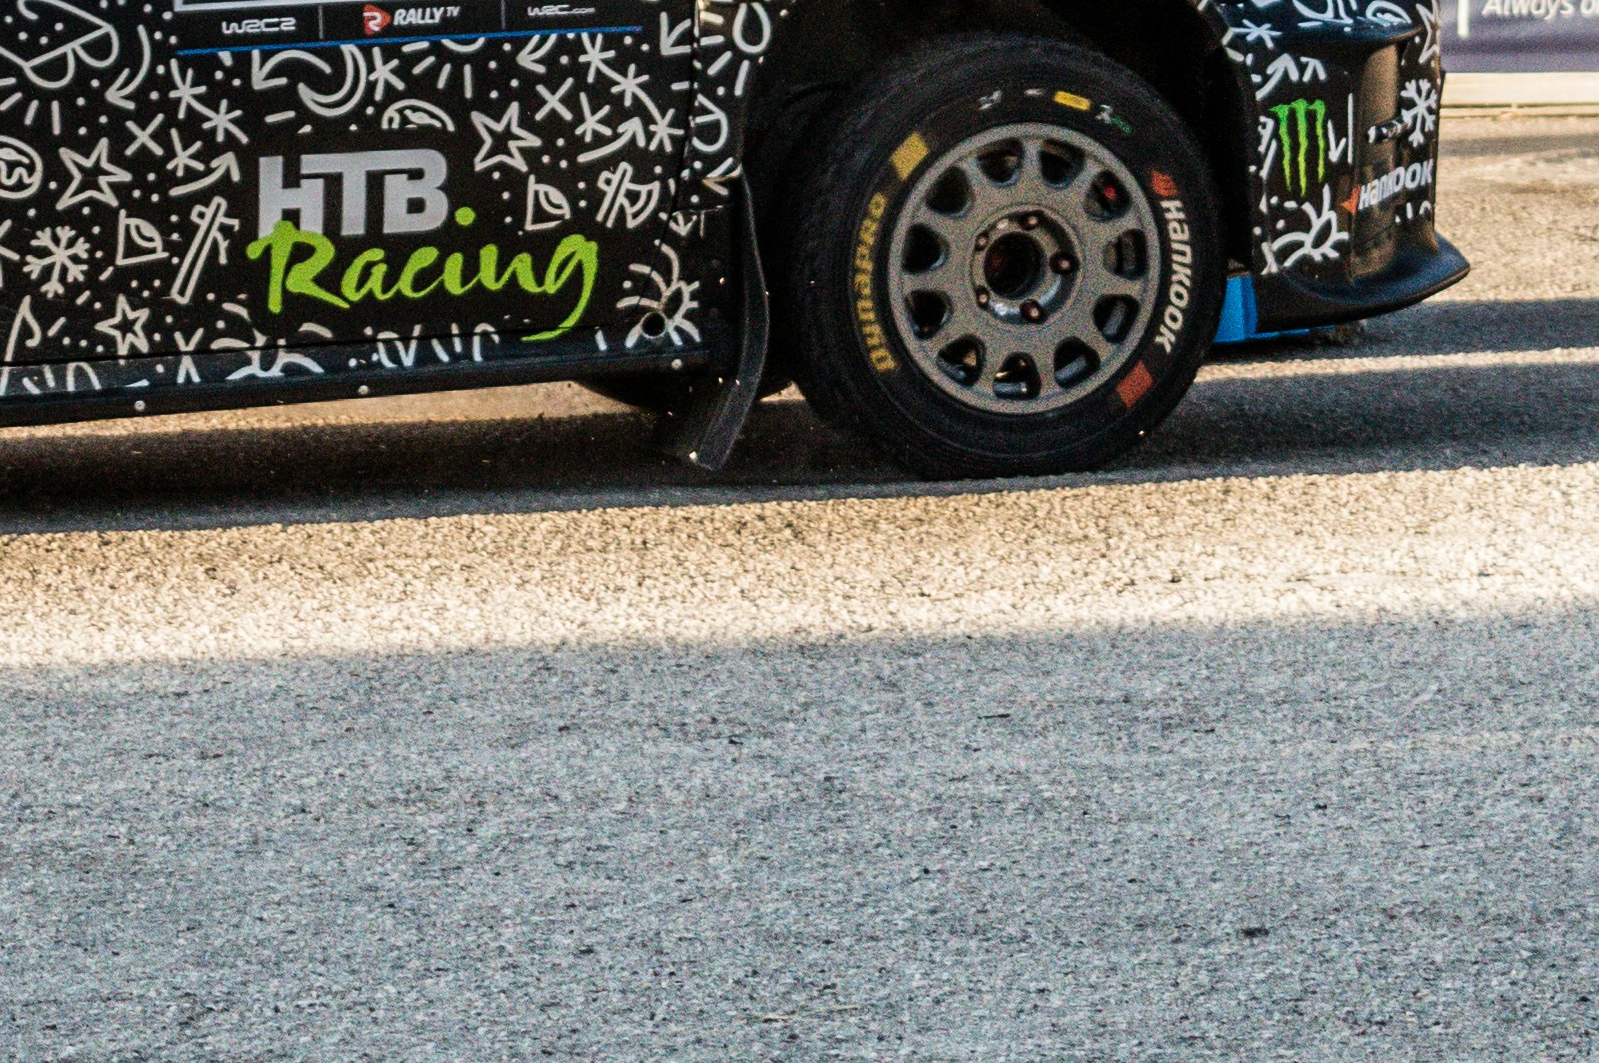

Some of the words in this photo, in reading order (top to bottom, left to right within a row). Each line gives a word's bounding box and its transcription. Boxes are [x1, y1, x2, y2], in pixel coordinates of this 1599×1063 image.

[221, 17, 297, 35] WRC2
[393, 6, 445, 26] RALLY
[246, 220, 599, 342] Racing
